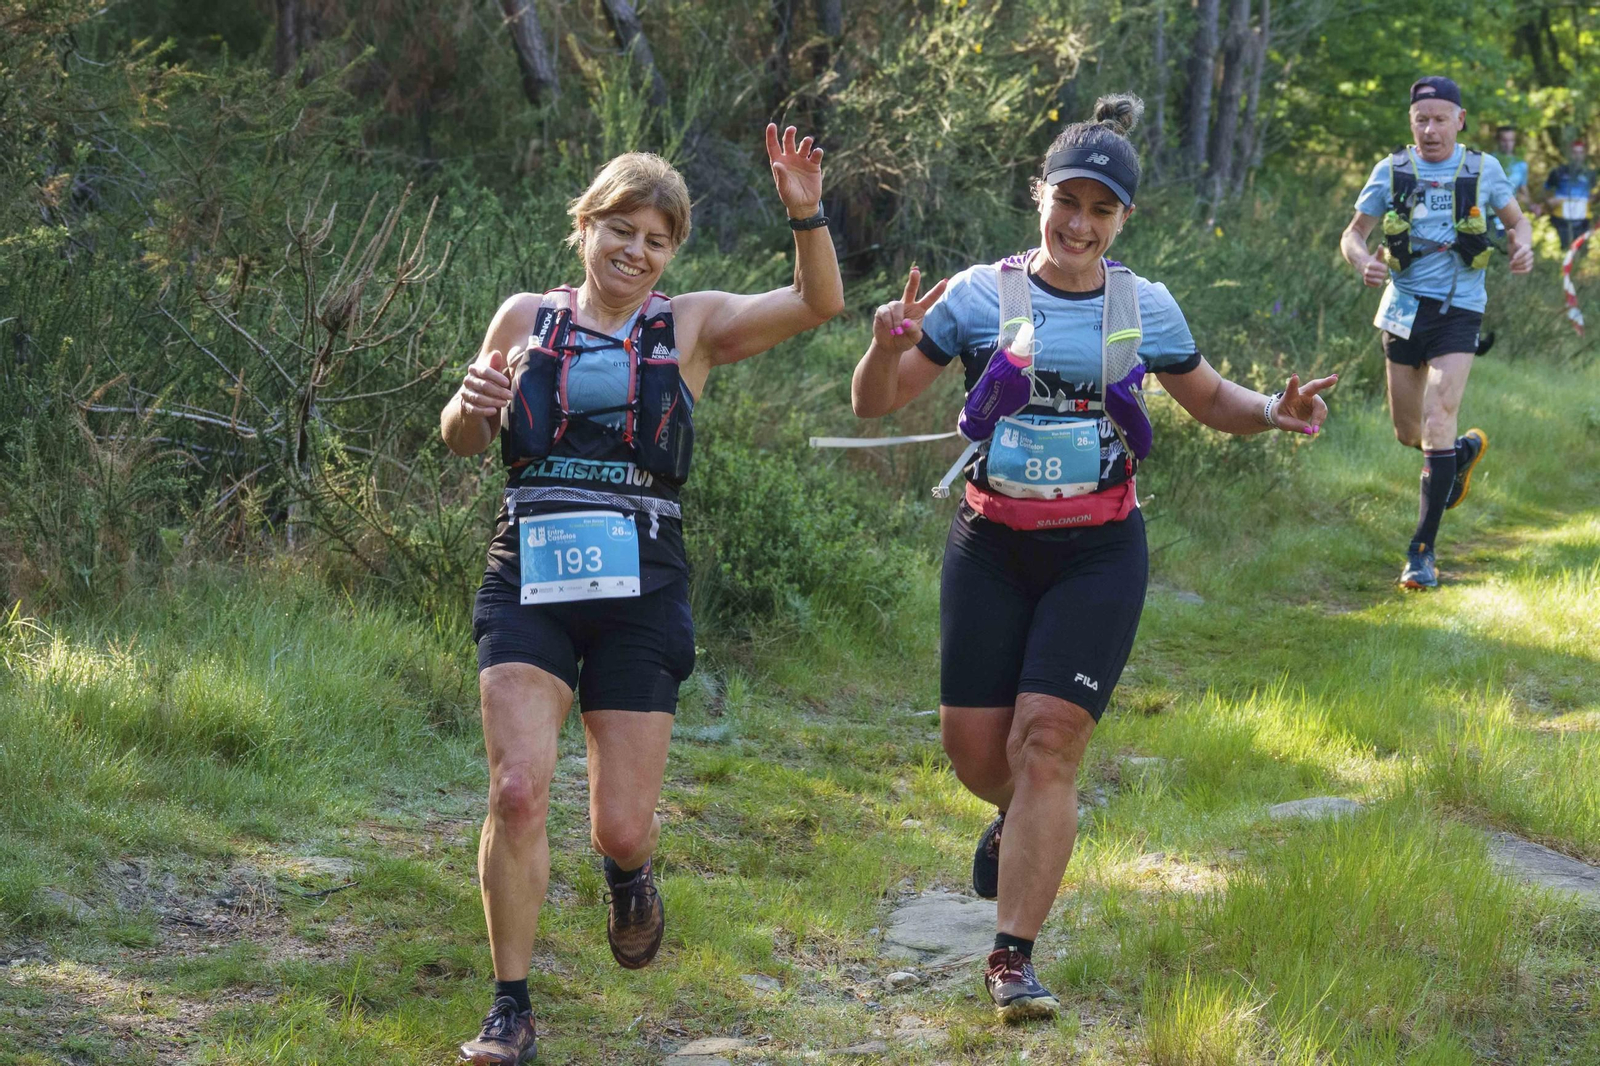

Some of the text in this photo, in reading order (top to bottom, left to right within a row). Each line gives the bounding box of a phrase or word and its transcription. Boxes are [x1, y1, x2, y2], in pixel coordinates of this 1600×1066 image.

[1431, 195, 1452, 203] Entr
[1077, 437, 1088, 446] 26
[1024, 457, 1062, 481] 88
[1036, 513, 1092, 528] SALOMON
[612, 526, 624, 536] 26
[554, 546, 603, 576] 193
[1074, 672, 1099, 691] FILA
